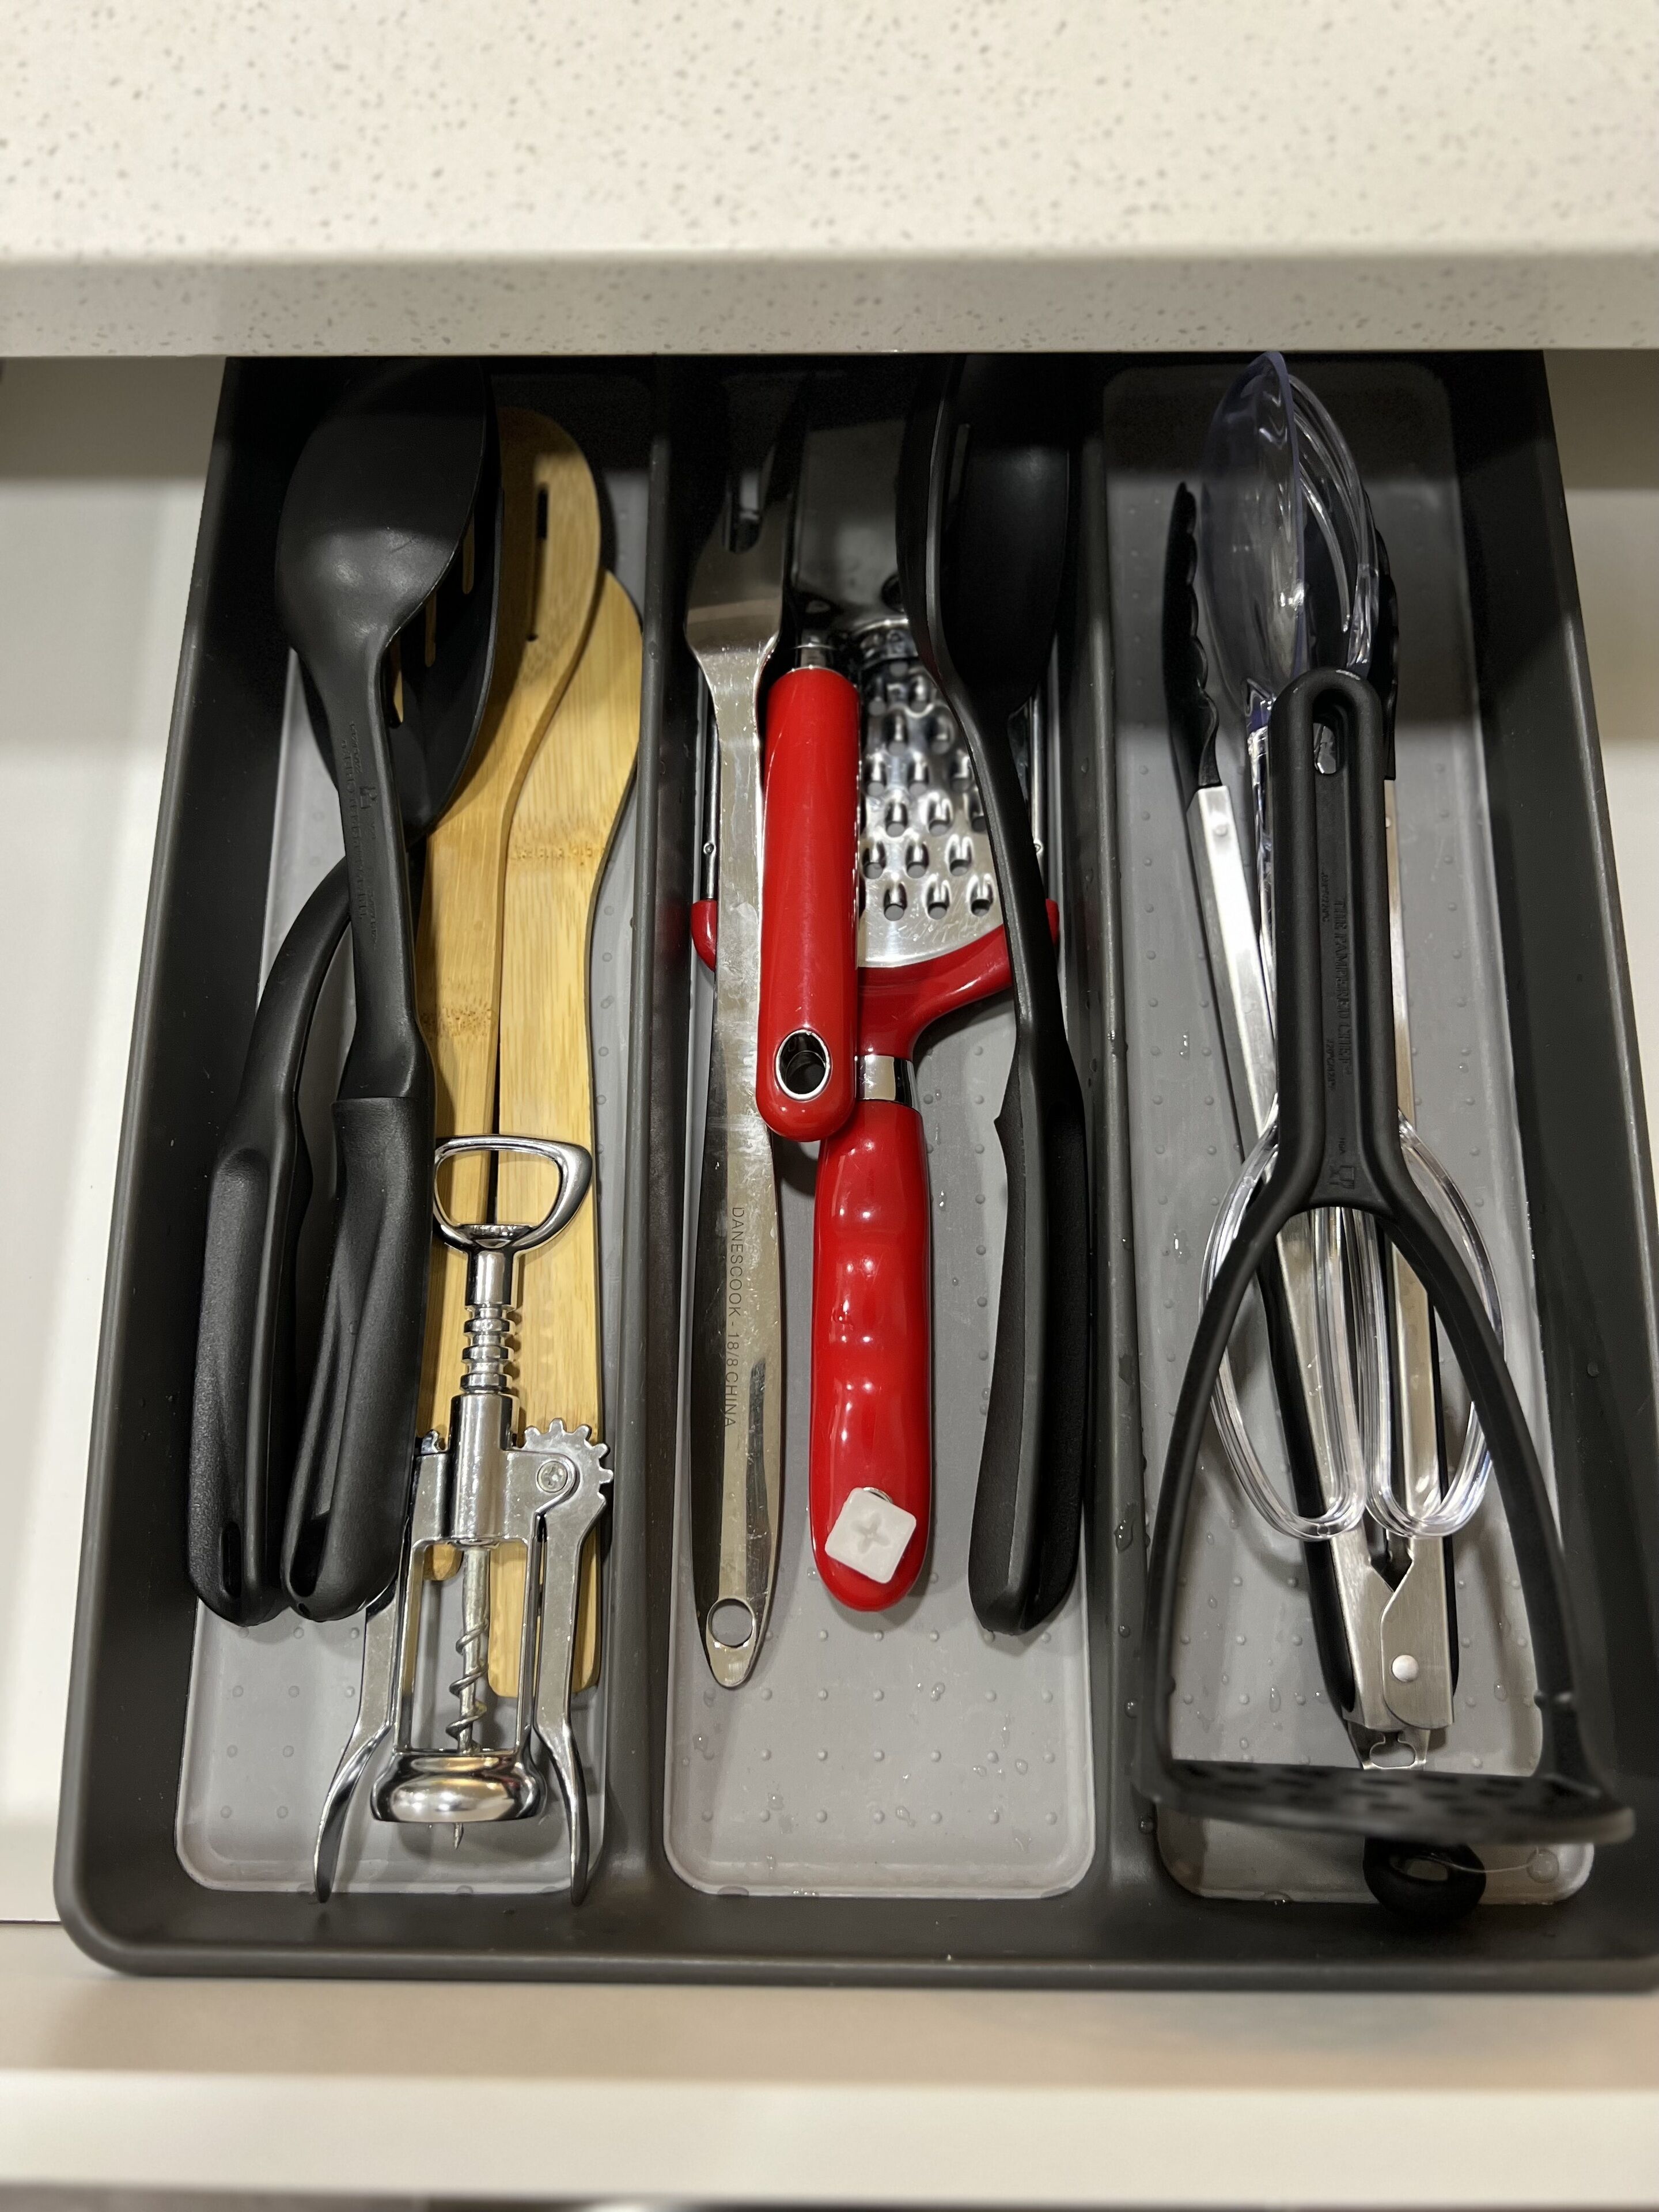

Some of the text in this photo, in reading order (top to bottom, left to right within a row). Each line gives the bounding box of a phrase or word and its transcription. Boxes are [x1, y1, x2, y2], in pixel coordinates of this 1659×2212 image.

[728, 1206, 745, 1317] DANESCOOK
[726, 1333, 740, 1367] 18/8
[724, 1371, 739, 1428] CHINA
